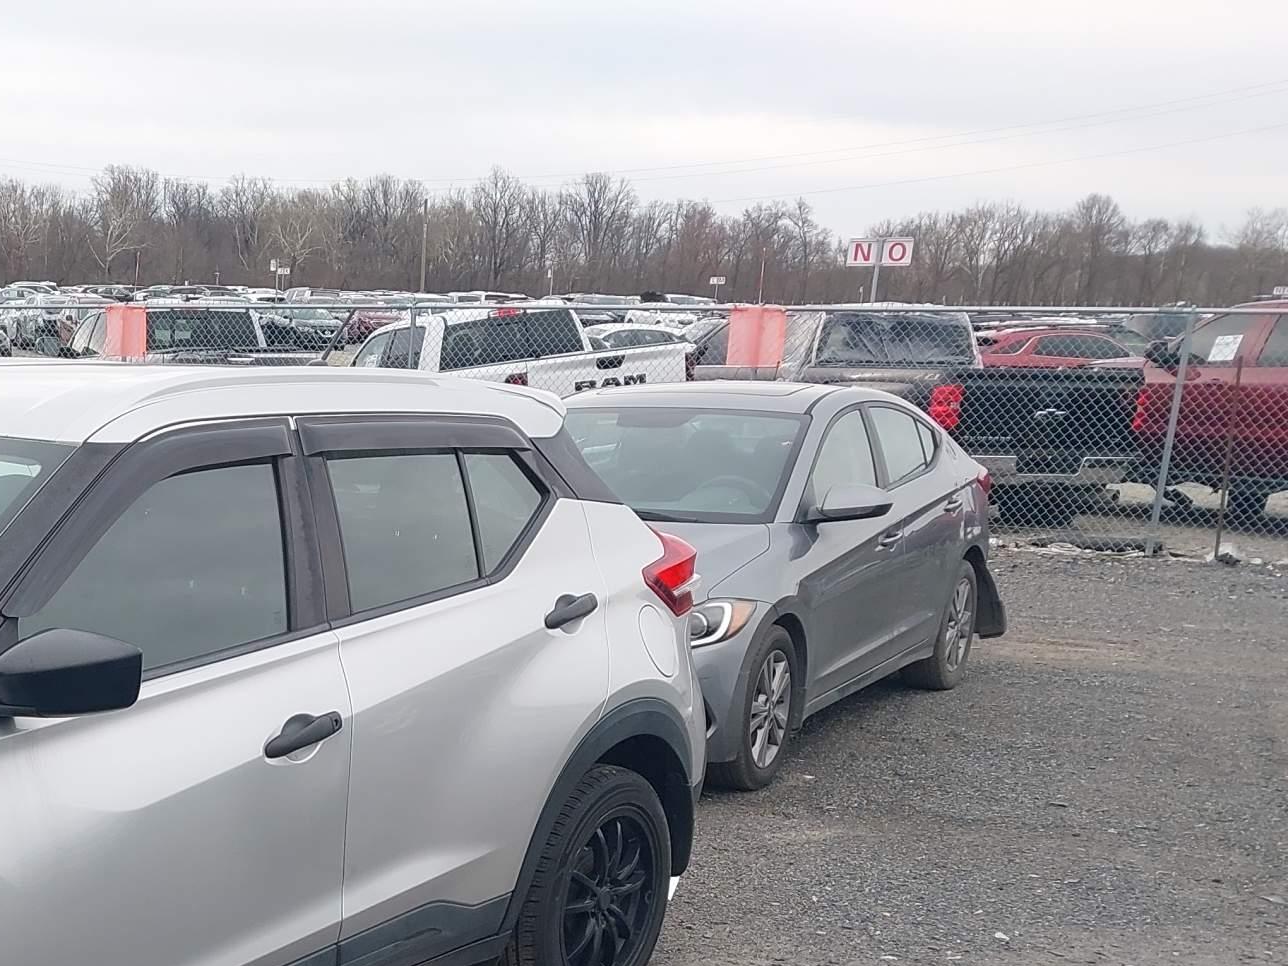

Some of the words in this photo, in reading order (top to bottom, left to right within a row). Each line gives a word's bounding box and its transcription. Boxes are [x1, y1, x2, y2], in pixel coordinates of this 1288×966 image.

[853, 243, 872, 262] N
[888, 242, 907, 262] O
[574, 373, 647, 392] RAM
